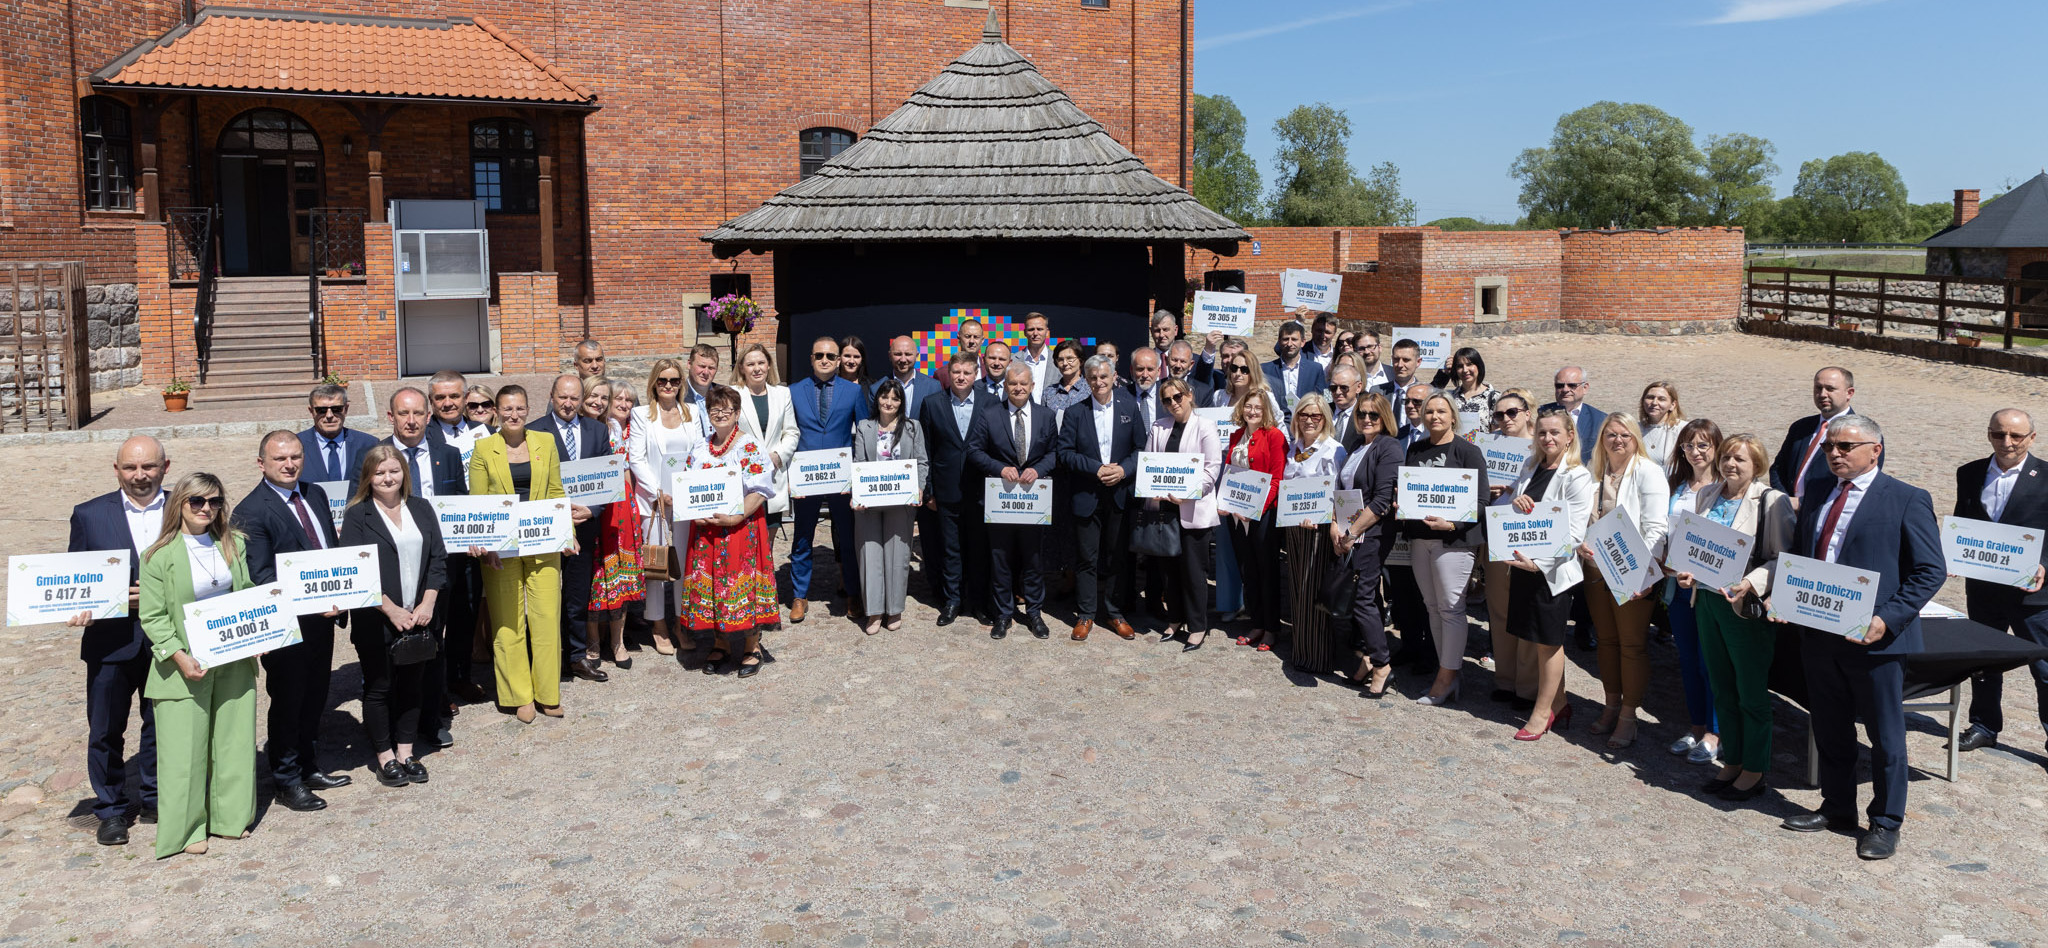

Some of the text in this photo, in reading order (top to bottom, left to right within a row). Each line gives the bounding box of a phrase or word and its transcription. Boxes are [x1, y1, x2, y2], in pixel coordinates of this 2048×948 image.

[1314, 283, 1328, 291] Lipsk
[1306, 290, 1317, 298] 957
[1220, 305, 1247, 314] Zambrów
[1218, 314, 1230, 322] 305
[1487, 449, 1524, 462] Gmina Czyże
[800, 462, 841, 472] Gmina Brańsk
[1166, 466, 1195, 474] Zabłudów
[1487, 460, 1518, 473] 30 197 zł
[578, 470, 619, 483] Siemiatycze
[804, 471, 836, 482] 24 862 zł
[880, 473, 910, 483] Hajnówka
[1152, 475, 1184, 484] 34 000 zł
[568, 485, 578, 494] 34
[580, 483, 595, 492] 000
[597, 481, 604, 490] zł
[689, 483, 725, 494] Gmina Łapy
[894, 482, 900, 491] zł
[1226, 479, 1261, 494] Gmina Wasilków
[1407, 482, 1468, 493] Gmina Jedwabne
[690, 492, 723, 504] 34 000 zł
[1230, 490, 1236, 498] 19
[1246, 494, 1252, 502] zł
[1287, 490, 1326, 501] Gmina Stawiski
[1418, 494, 1455, 504] 25 500 zł
[330, 498, 346, 507] Turo
[1292, 501, 1317, 511] 16 235 zł
[441, 512, 510, 524] Gmina Poświętne
[533, 516, 554, 526] Sejny
[453, 523, 495, 534] 34 000 zł
[1502, 519, 1553, 531] Gmina Sokoły
[524, 528, 540, 538] 000
[542, 527, 550, 536] zł
[1508, 530, 1547, 542] 26 435 zł
[1613, 531, 1639, 570] Gmina Giby
[1685, 532, 1737, 560] Gmina Grodzisk
[1956, 535, 2024, 554] Gmina Grajewo
[1604, 538, 1629, 575] 34 000 zł
[1688, 546, 1699, 558] 34
[1700, 551, 1715, 565] 000
[1716, 558, 1724, 569] zł
[1962, 548, 2010, 565] 34 000 zł
[300, 566, 358, 580] Gmina Wizna
[36, 573, 103, 586] Gmina Kolno
[304, 578, 352, 594] 34 000 zł
[1786, 574, 1862, 601] Gmina Drohiczyn
[45, 586, 91, 601] 6 417 zł
[1796, 591, 1844, 612] 30 038 zł
[207, 604, 278, 630] Gmina Piątnica
[218, 628, 234, 642] 34
[236, 622, 257, 638] 000
[259, 619, 269, 632] zł
